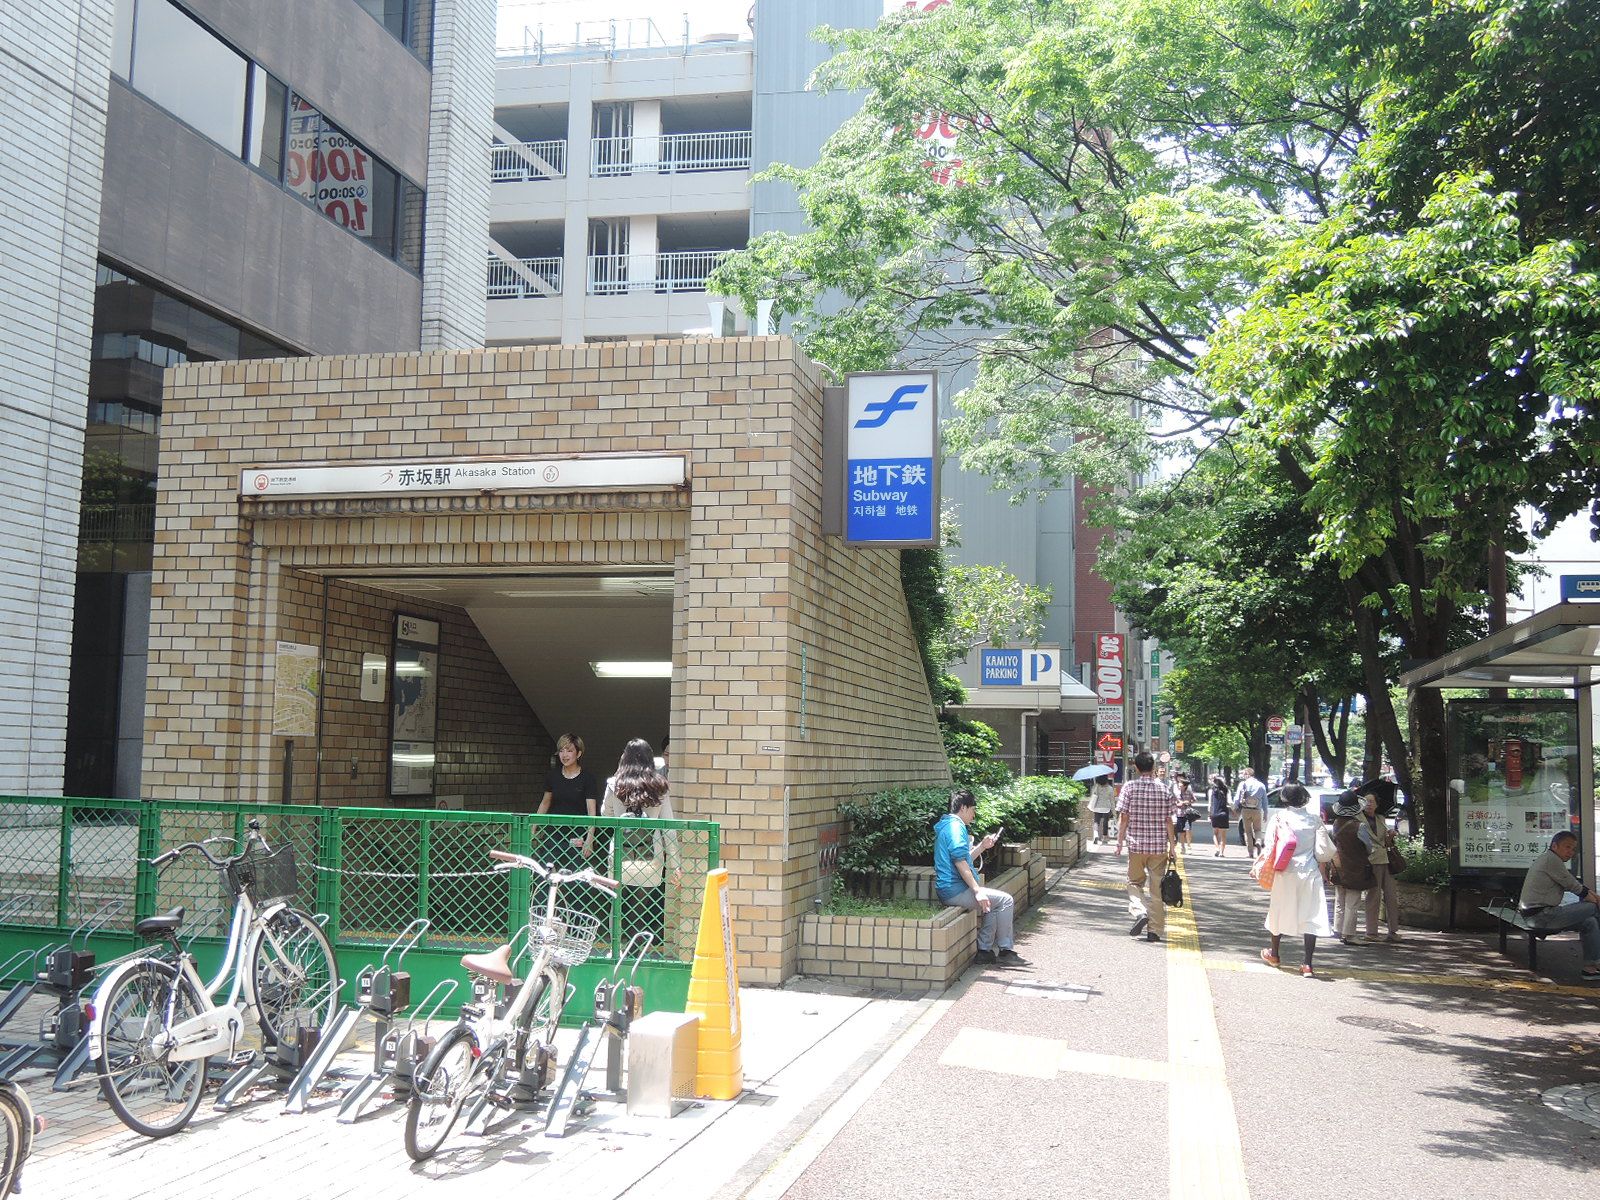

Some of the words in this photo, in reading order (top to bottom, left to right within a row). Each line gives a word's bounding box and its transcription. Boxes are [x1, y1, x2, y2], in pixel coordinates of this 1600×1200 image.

[398, 467, 451, 486] 赤坂駅
[454, 467, 497, 478] Akasaka
[501, 465, 536, 476] Station
[853, 464, 926, 487] 地下鉄
[853, 489, 908, 503] Subway
[853, 505, 886, 517] 지하철
[985, 655, 1019, 667] KAMIYO
[1030, 653, 1053, 682] P
[985, 667, 1018, 679] PARKING
